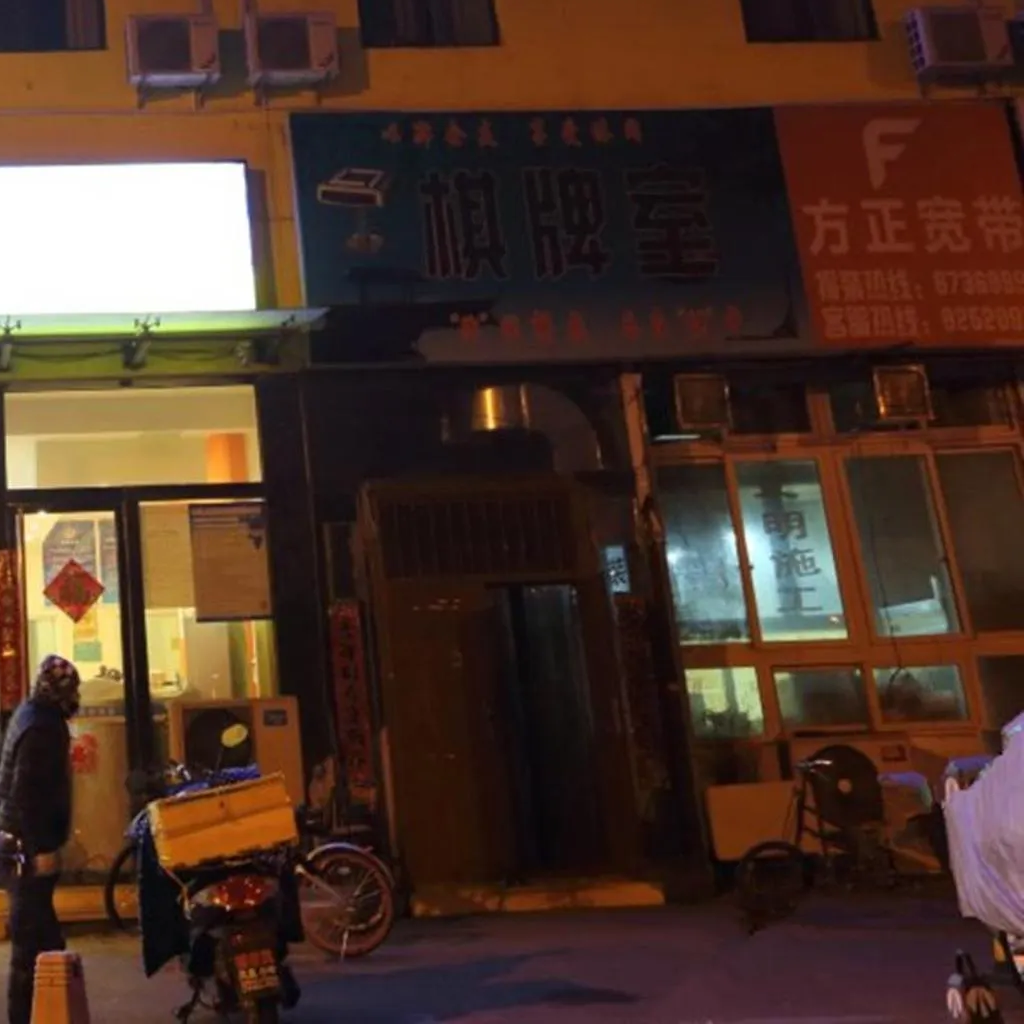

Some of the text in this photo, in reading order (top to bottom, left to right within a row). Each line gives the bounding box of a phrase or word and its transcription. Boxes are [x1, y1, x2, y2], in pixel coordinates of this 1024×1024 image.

[418, 162, 721, 282] 棋牌室
[800, 193, 1024, 256] 方正宽带
